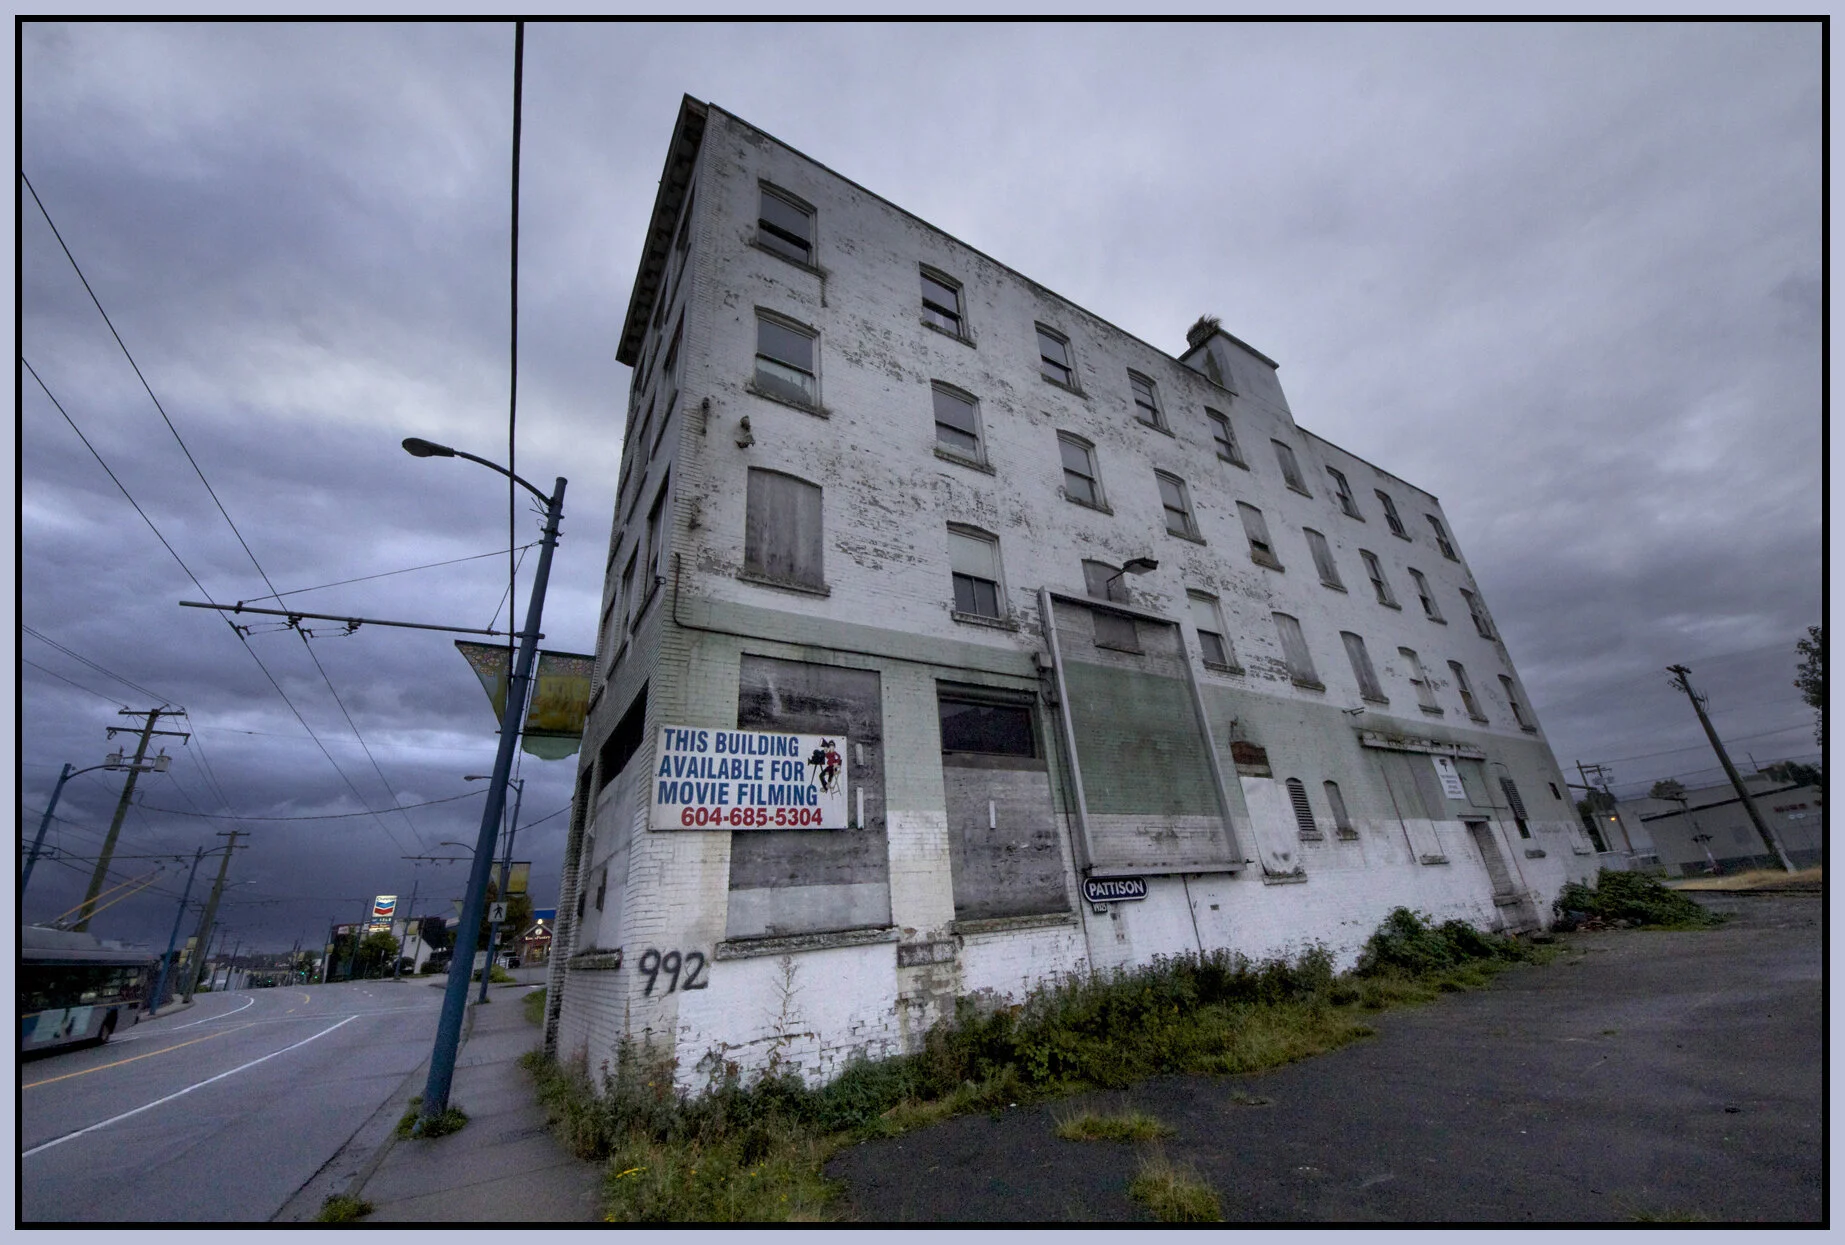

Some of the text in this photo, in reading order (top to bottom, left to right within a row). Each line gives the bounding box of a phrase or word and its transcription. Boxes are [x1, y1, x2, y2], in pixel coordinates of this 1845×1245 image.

[664, 729, 799, 757] THIS BUILDING
[658, 755, 805, 782] AVAILABLE FOR
[657, 781, 818, 806] MOVIE FILMING
[681, 807, 823, 826] 604-685-5304
[1088, 880, 1144, 896] PATTISON
[639, 948, 709, 997] 992
